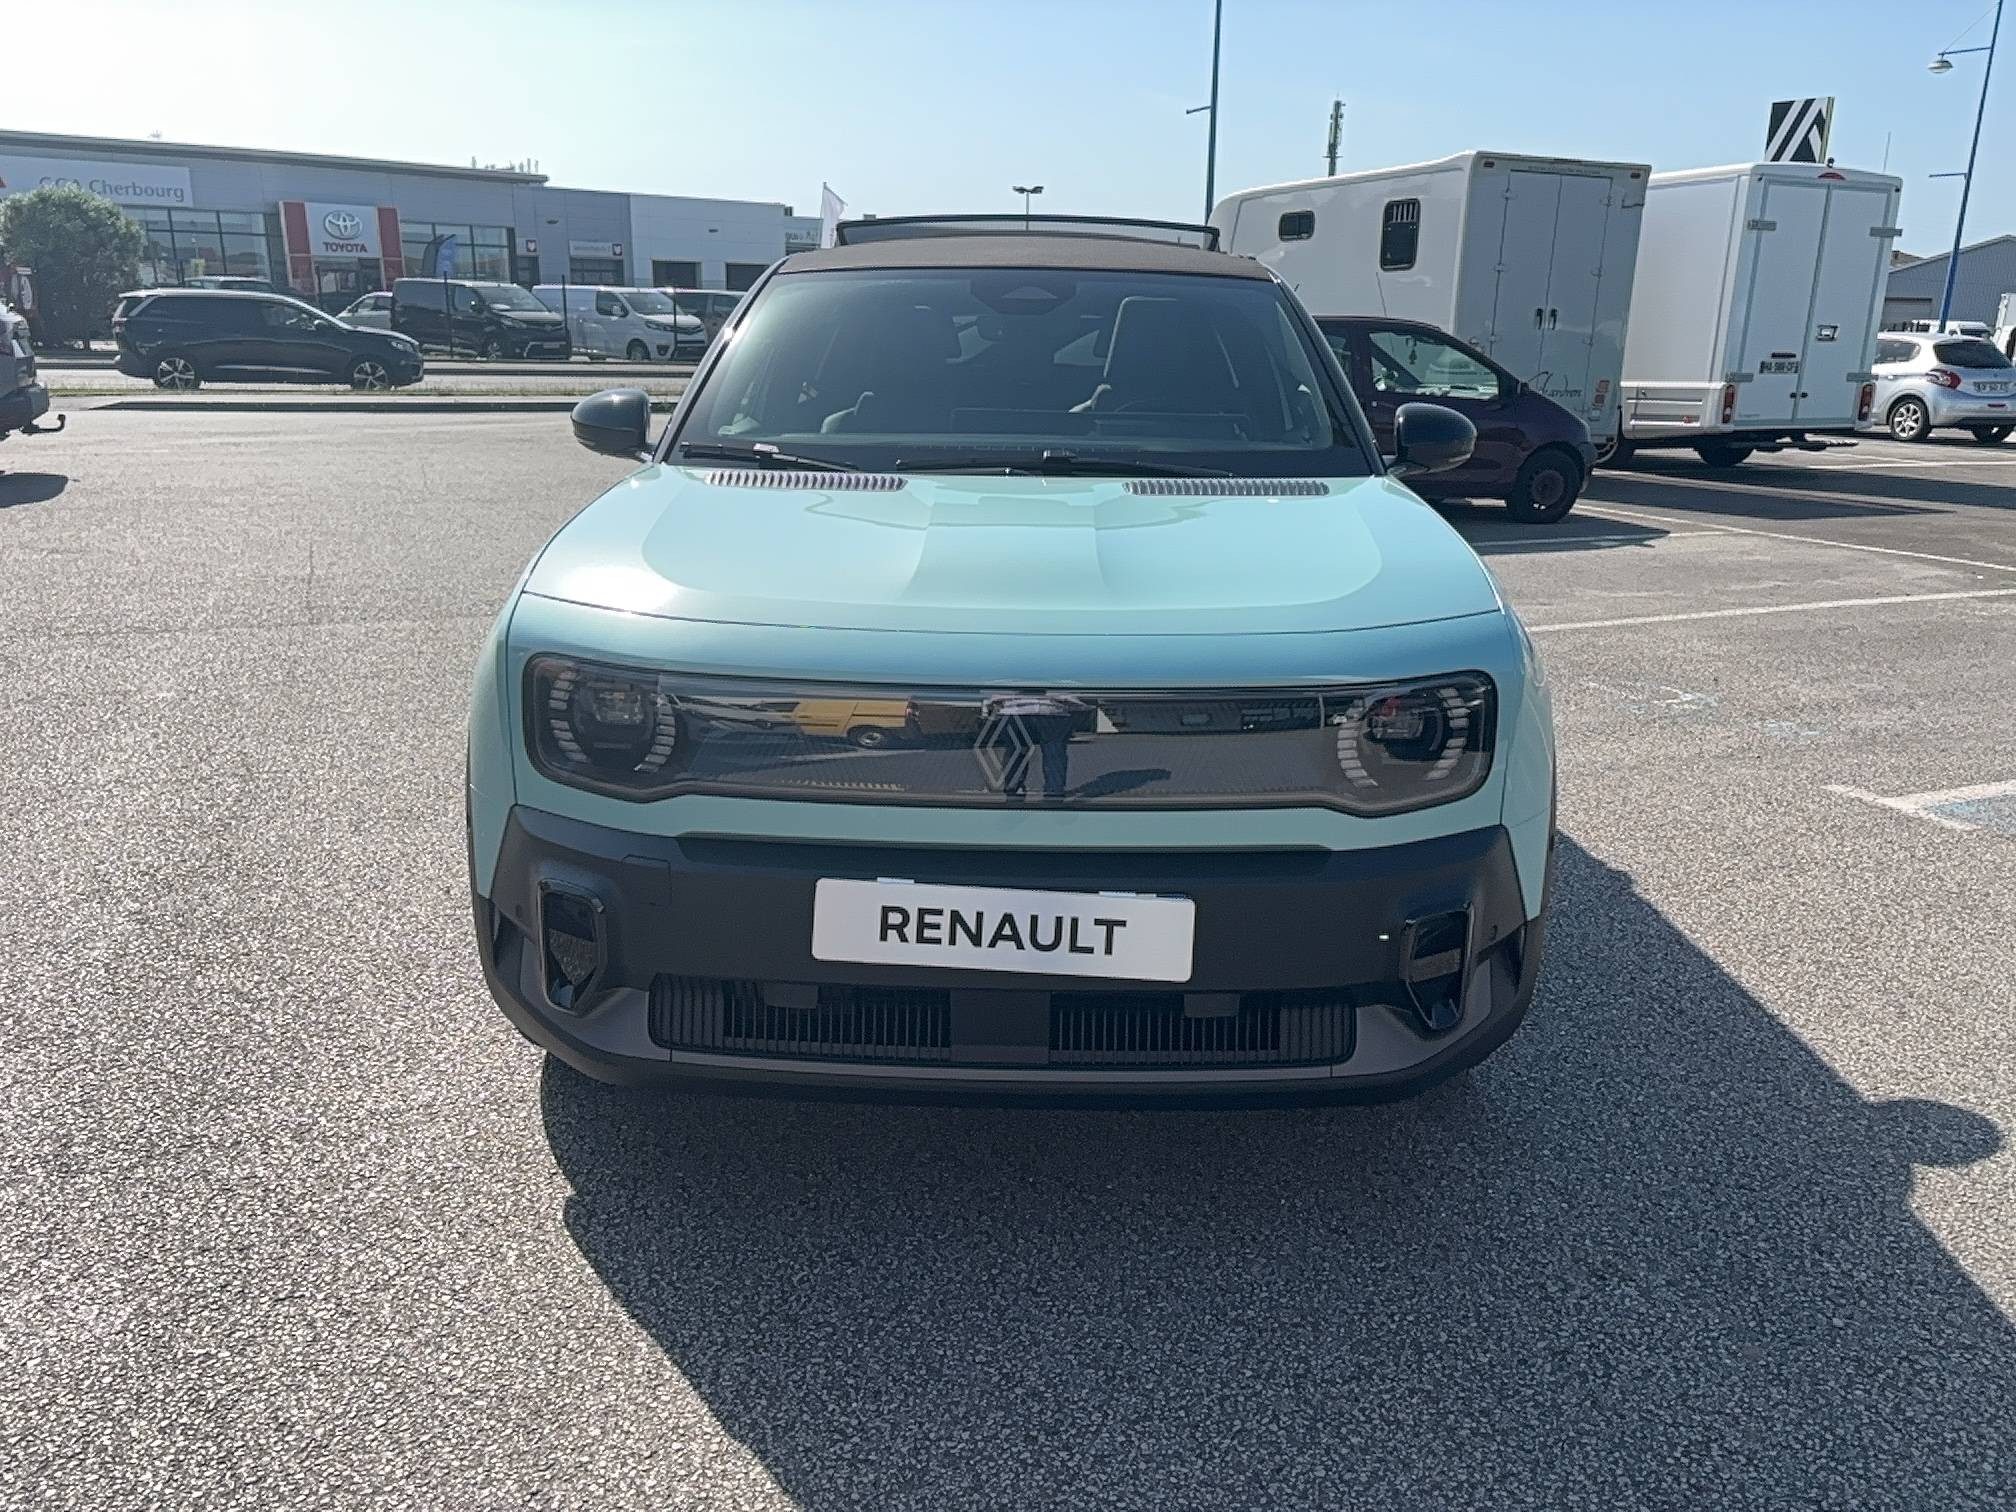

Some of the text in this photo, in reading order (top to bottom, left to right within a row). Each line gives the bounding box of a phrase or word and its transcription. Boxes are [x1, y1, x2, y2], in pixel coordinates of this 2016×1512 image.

[88, 178, 185, 203] Cherbourg
[322, 241, 368, 253] TOYOTA
[879, 904, 1127, 956] RENAULT
